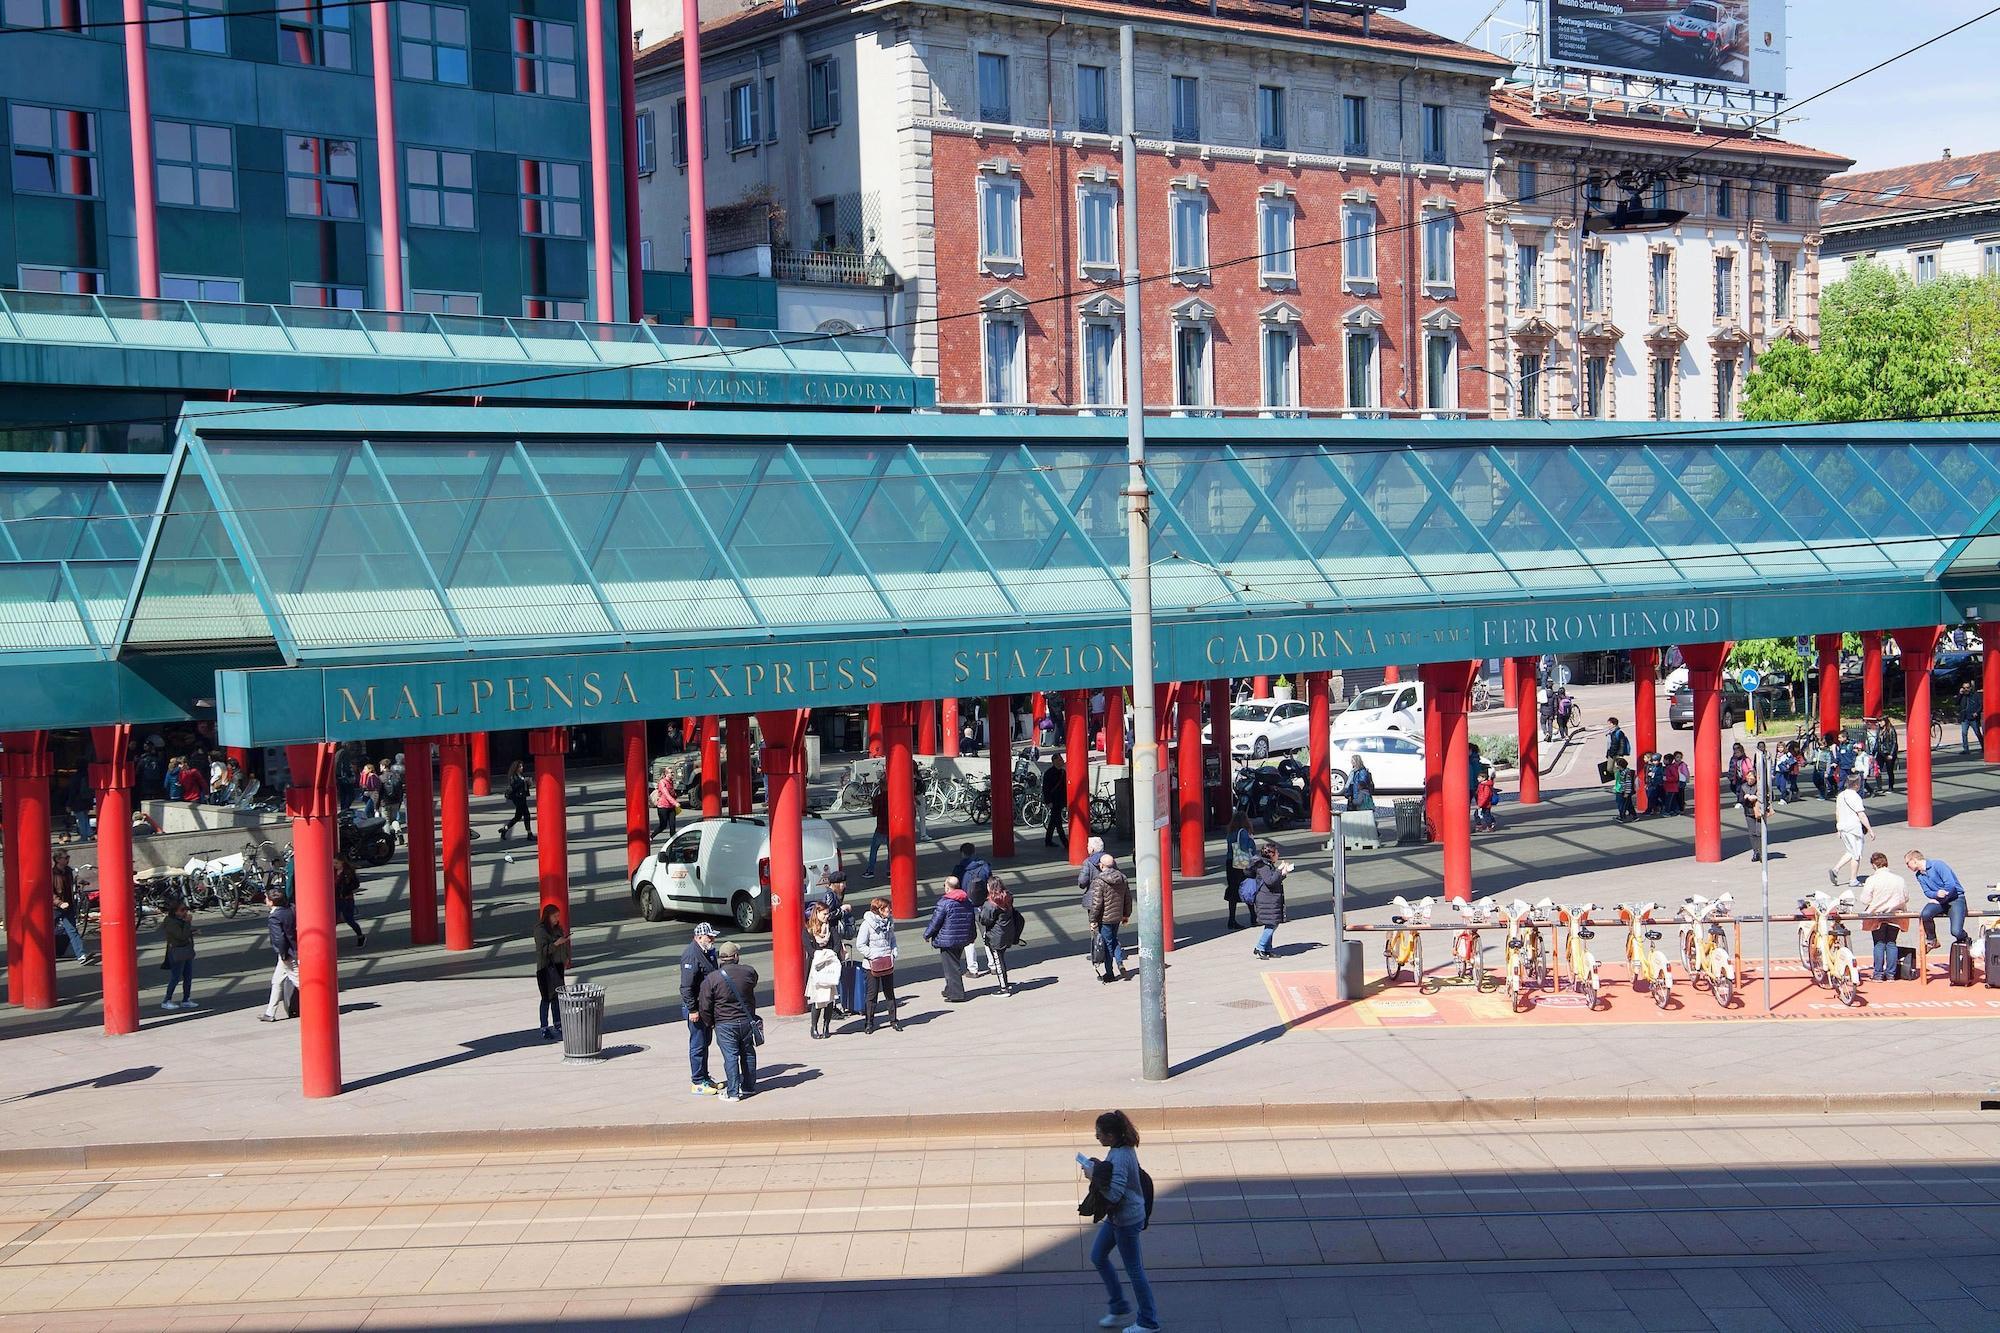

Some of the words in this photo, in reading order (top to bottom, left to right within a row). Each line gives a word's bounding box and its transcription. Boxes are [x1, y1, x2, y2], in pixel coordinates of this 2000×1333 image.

[1580, 0, 1624, 15] Sant'Ambrogio
[1586, 20, 1602, 29] Service
[667, 377, 769, 396] STAZIONE
[805, 382, 906, 400] CADORNA
[338, 671, 640, 724] MALPENSA
[672, 656, 878, 702] EXPRESS
[1206, 628, 1378, 665] CADORNA
[1483, 607, 1720, 647] FERROVIENORD
